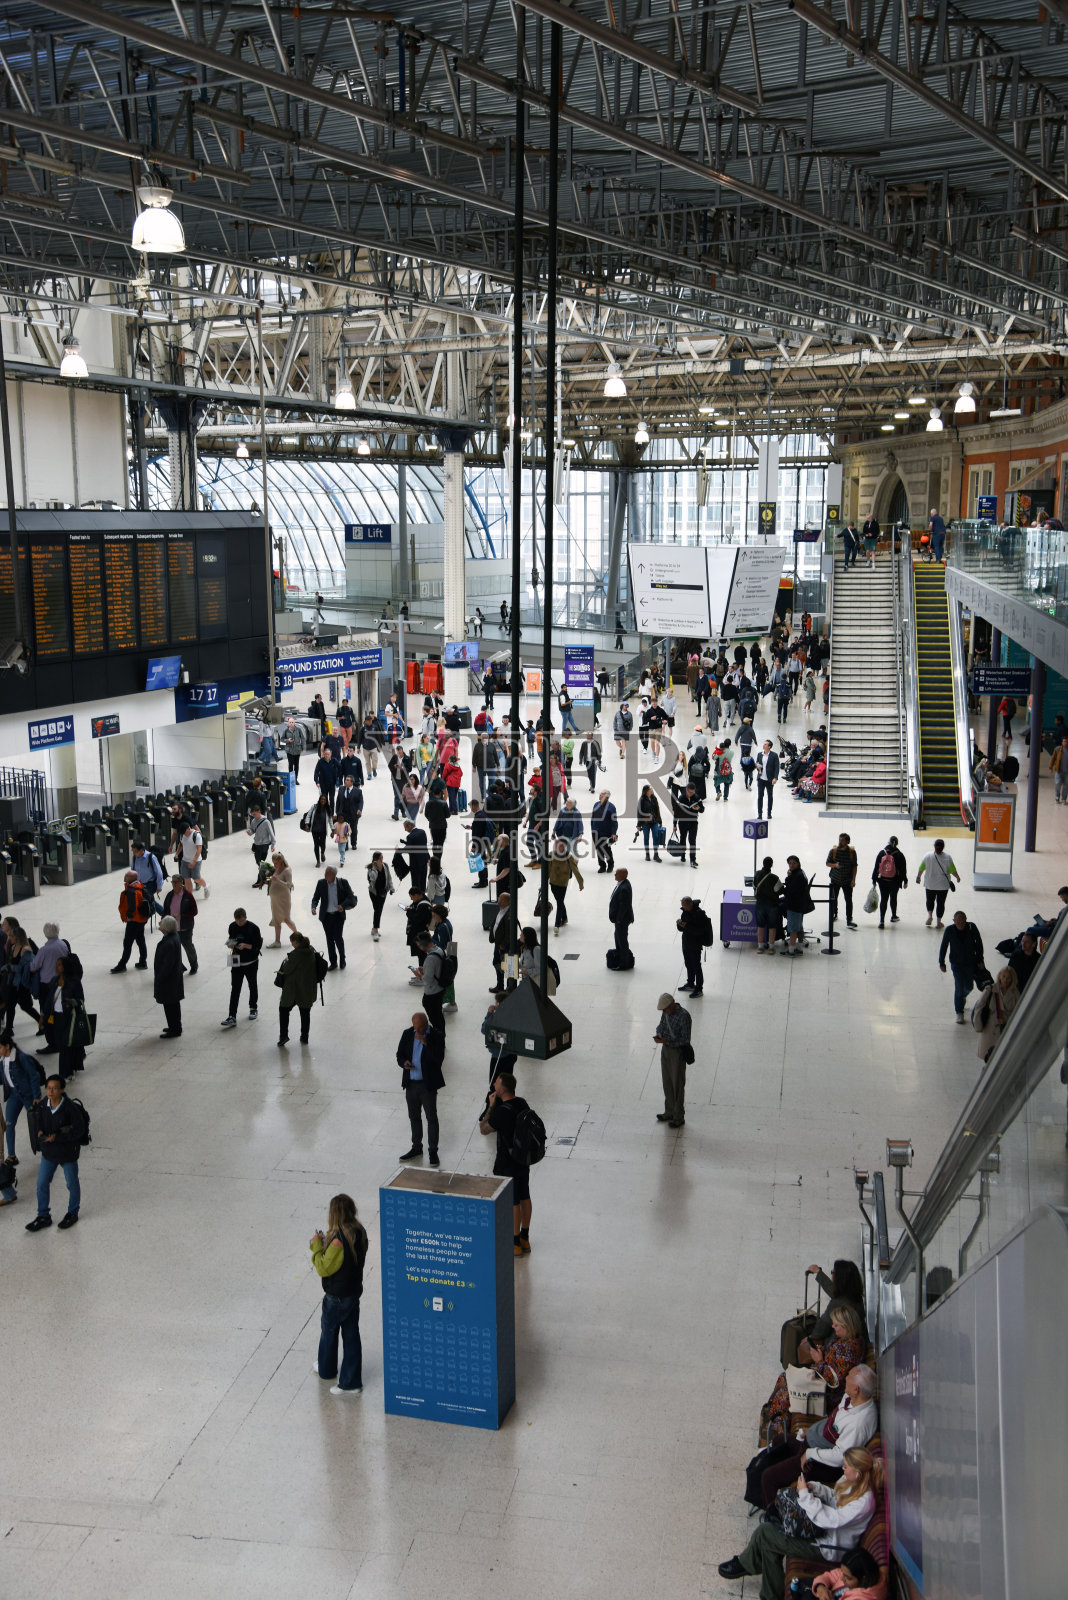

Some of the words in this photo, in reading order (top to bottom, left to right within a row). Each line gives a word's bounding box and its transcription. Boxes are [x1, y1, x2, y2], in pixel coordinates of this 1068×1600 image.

[368, 528, 383, 538] Lift
[313, 658, 344, 670] STATION
[284, 675, 292, 686] 18
[189, 689, 204, 700] 17
[207, 688, 217, 700] 17
[406, 1228, 434, 1238] Together,
[406, 1244, 435, 1253] homeless
[406, 1274, 419, 1282] Tap
[430, 1277, 455, 1286] donate
